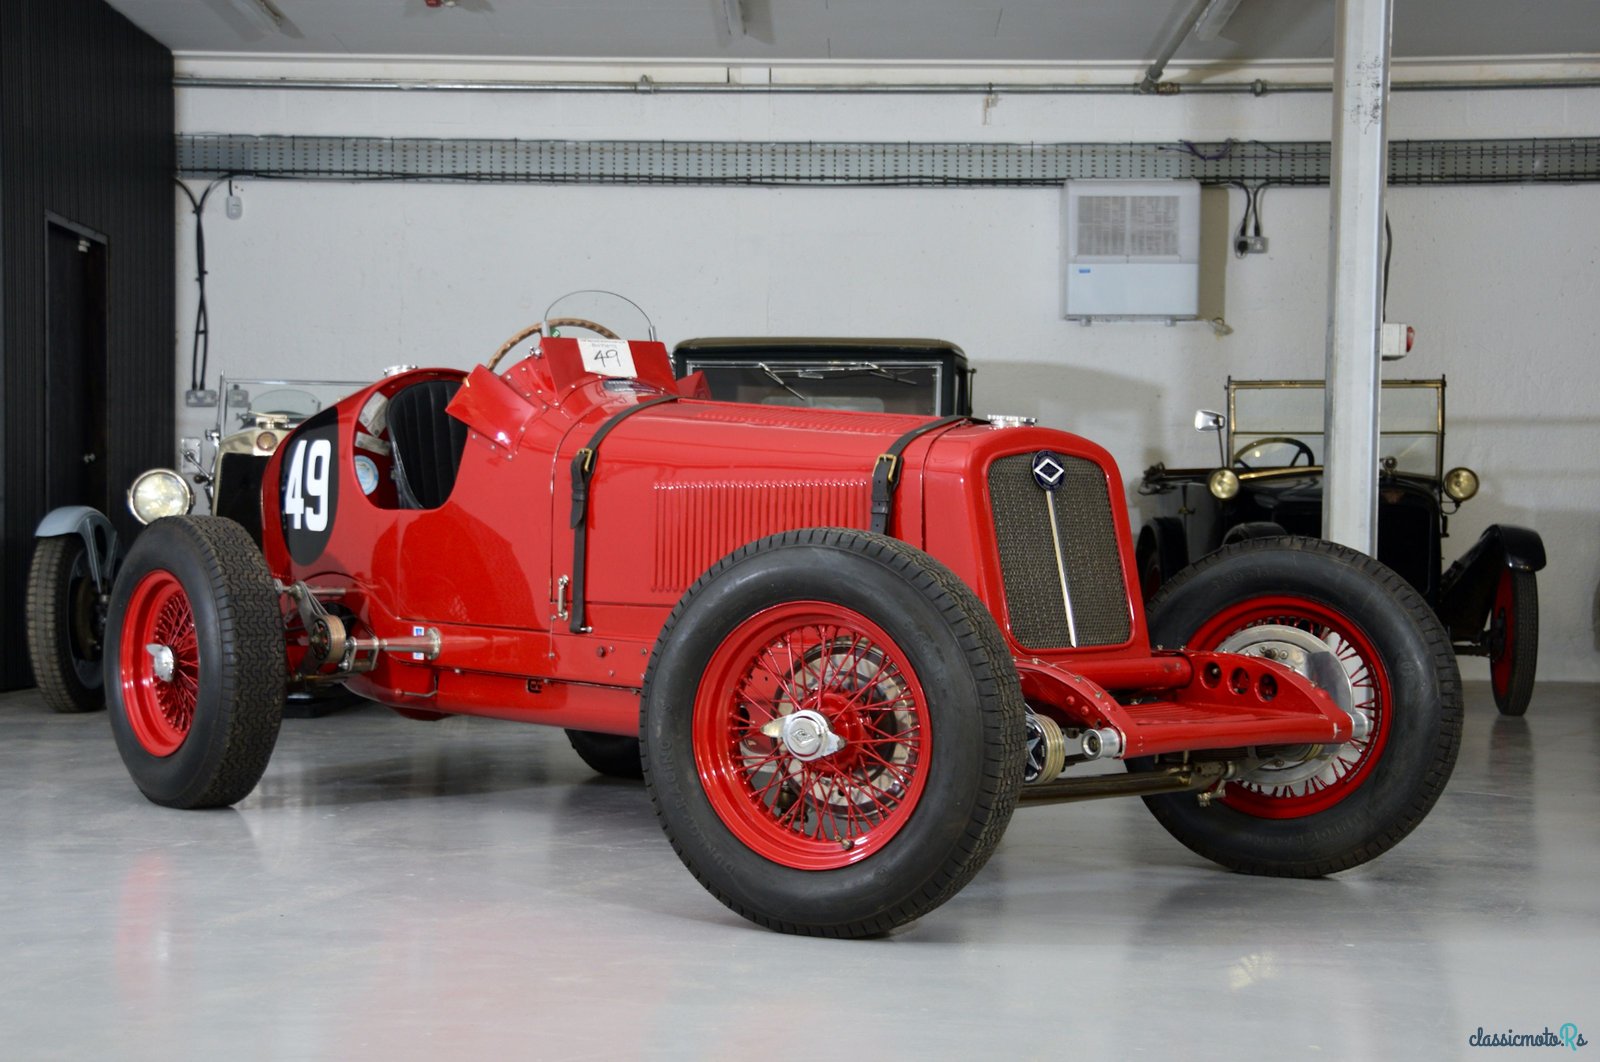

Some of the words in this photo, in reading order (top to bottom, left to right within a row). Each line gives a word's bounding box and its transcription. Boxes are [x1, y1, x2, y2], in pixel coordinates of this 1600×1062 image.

[594, 349, 621, 368] 49
[285, 439, 331, 532] 49
[660, 739, 688, 810] RACING
[681, 814, 736, 875] DUNLOP
